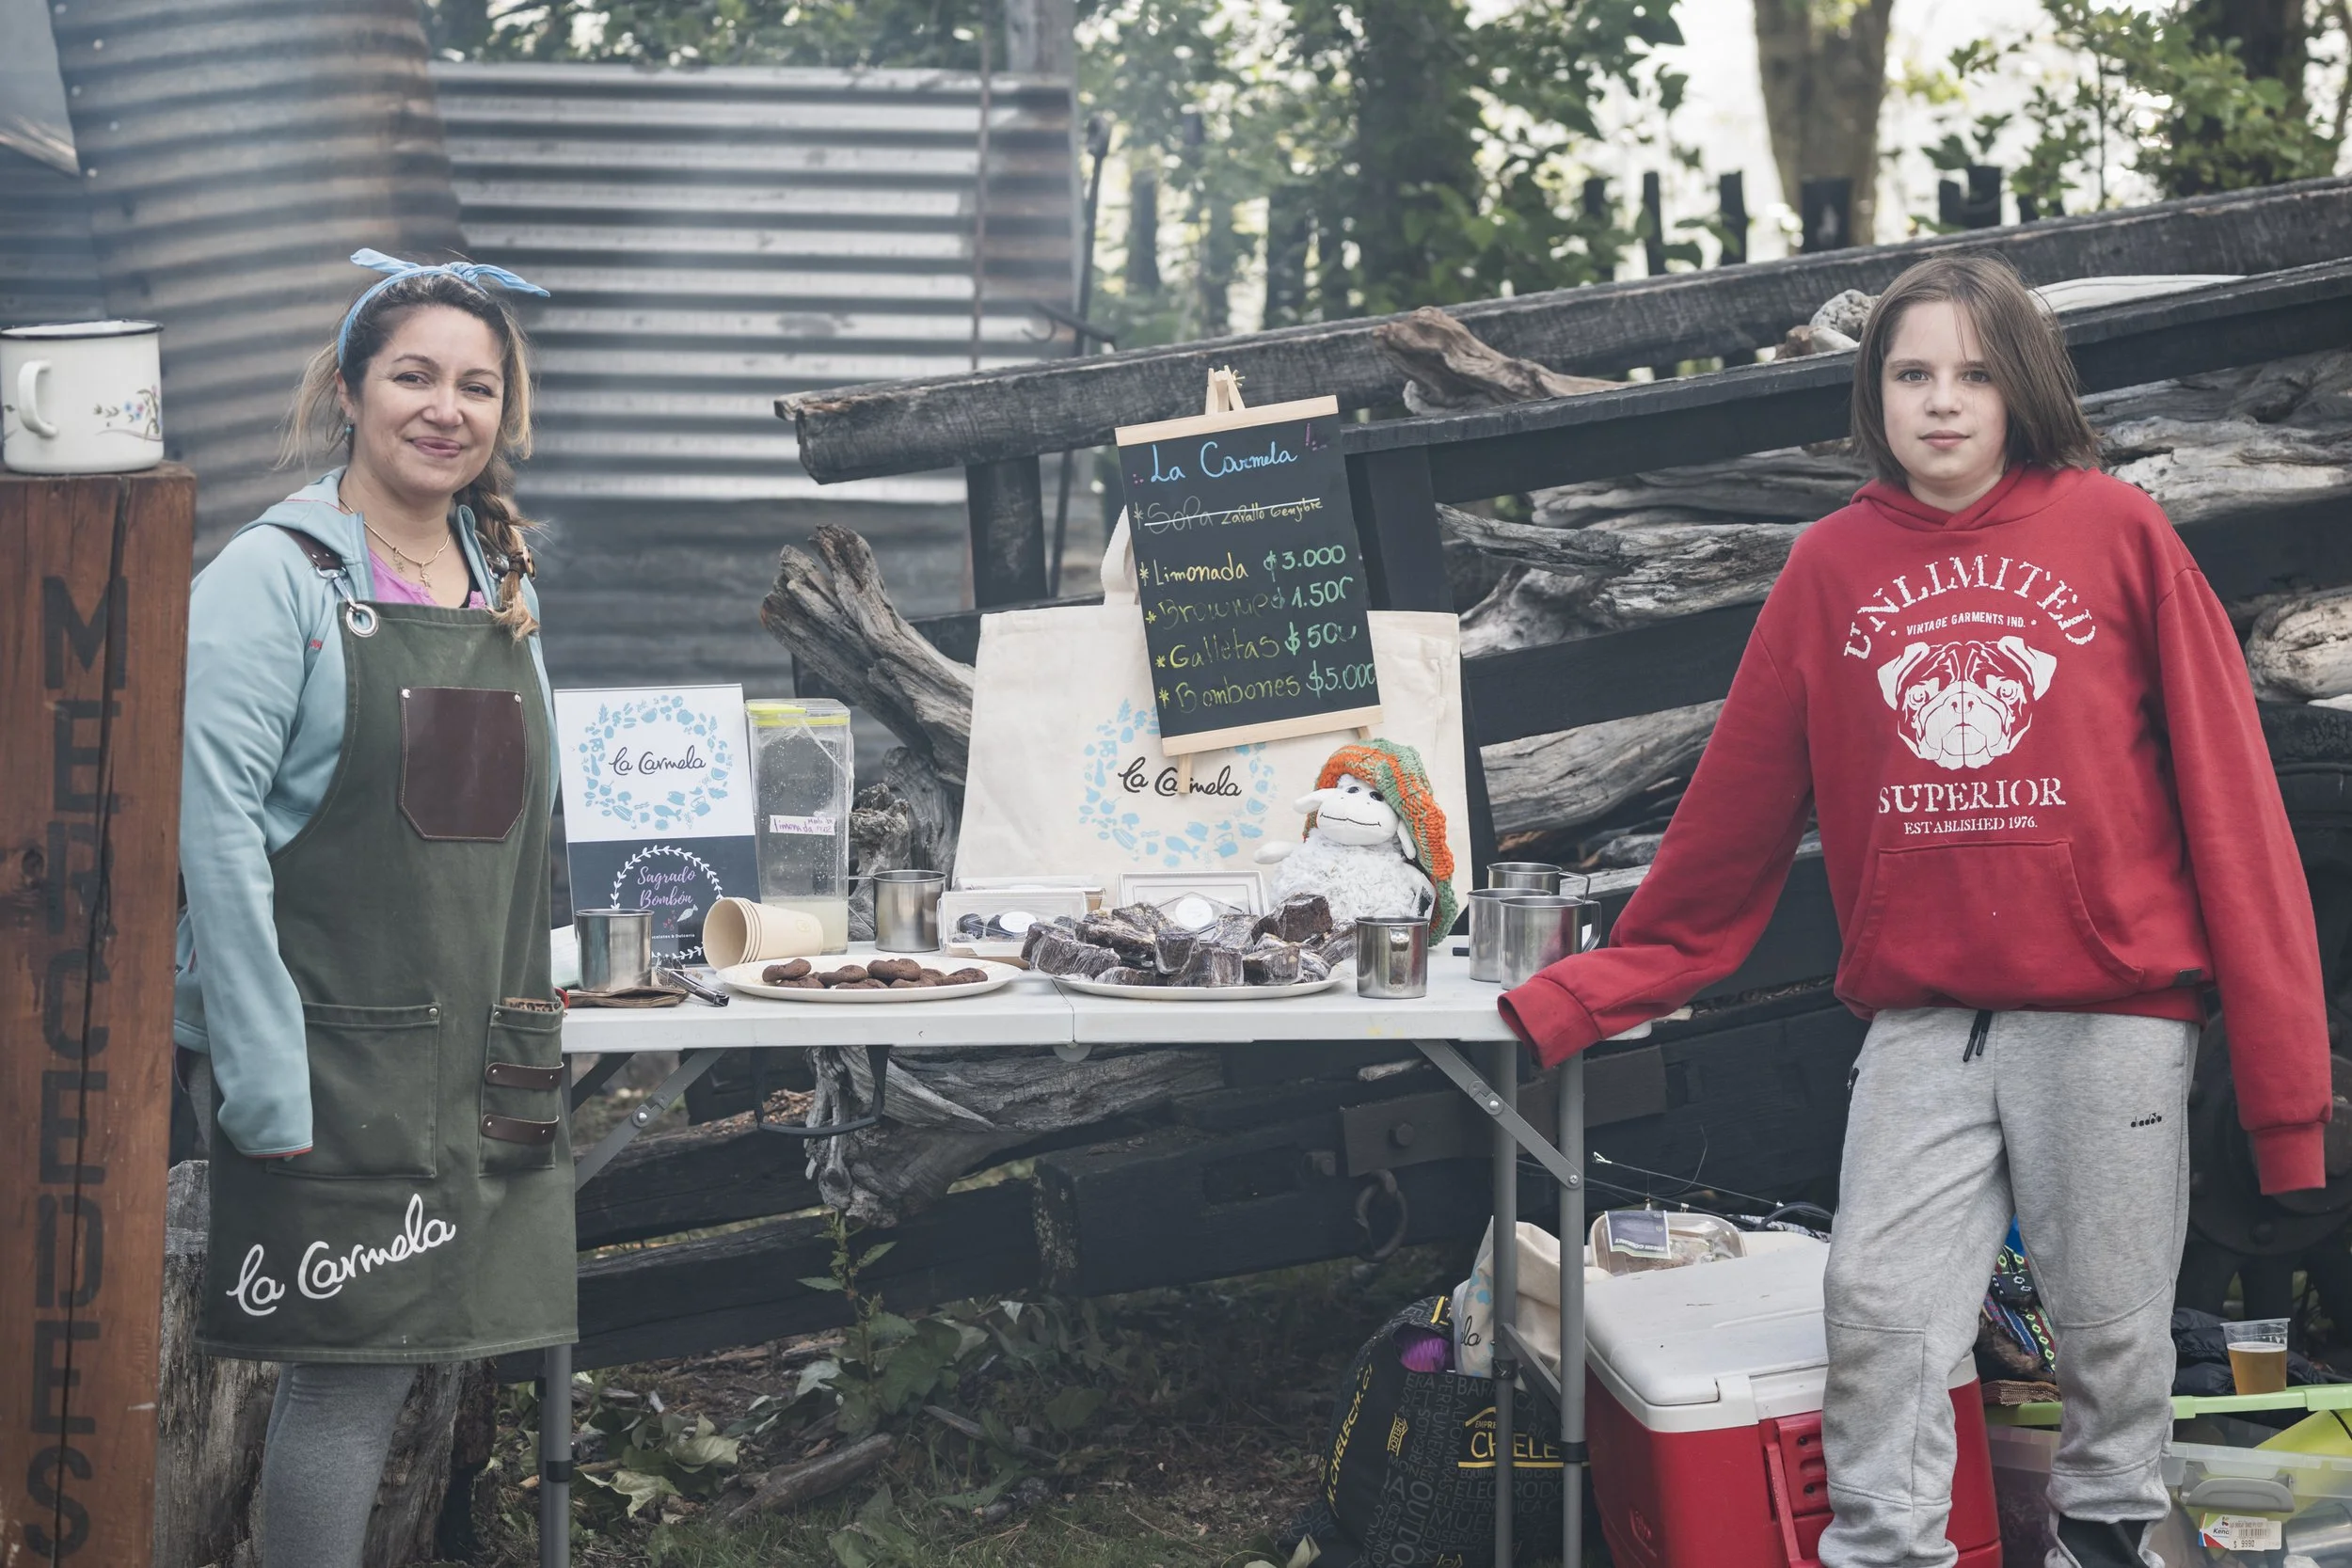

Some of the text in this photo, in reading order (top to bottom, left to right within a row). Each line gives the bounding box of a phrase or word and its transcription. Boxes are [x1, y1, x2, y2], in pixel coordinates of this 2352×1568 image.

[1150, 440, 1298, 483] La Carmela
[1152, 551, 1249, 587] Limonada
[1843, 553, 2096, 660] UNLIMITED
[1906, 616, 1948, 636] VINTAGE
[1951, 611, 2004, 626] GARMENTS
[638, 744, 707, 775] Carmela
[1153, 765, 1243, 797] Camela
[1878, 777, 2067, 815] SUPERIOR
[1903, 816, 2039, 835] ESTABLISHED 1976.
[637, 865, 696, 891] Sagrado
[639, 885, 693, 910] Bombón
[23, 575, 128, 1560] MERCEDES
[296, 1193, 456, 1300] Carmela
